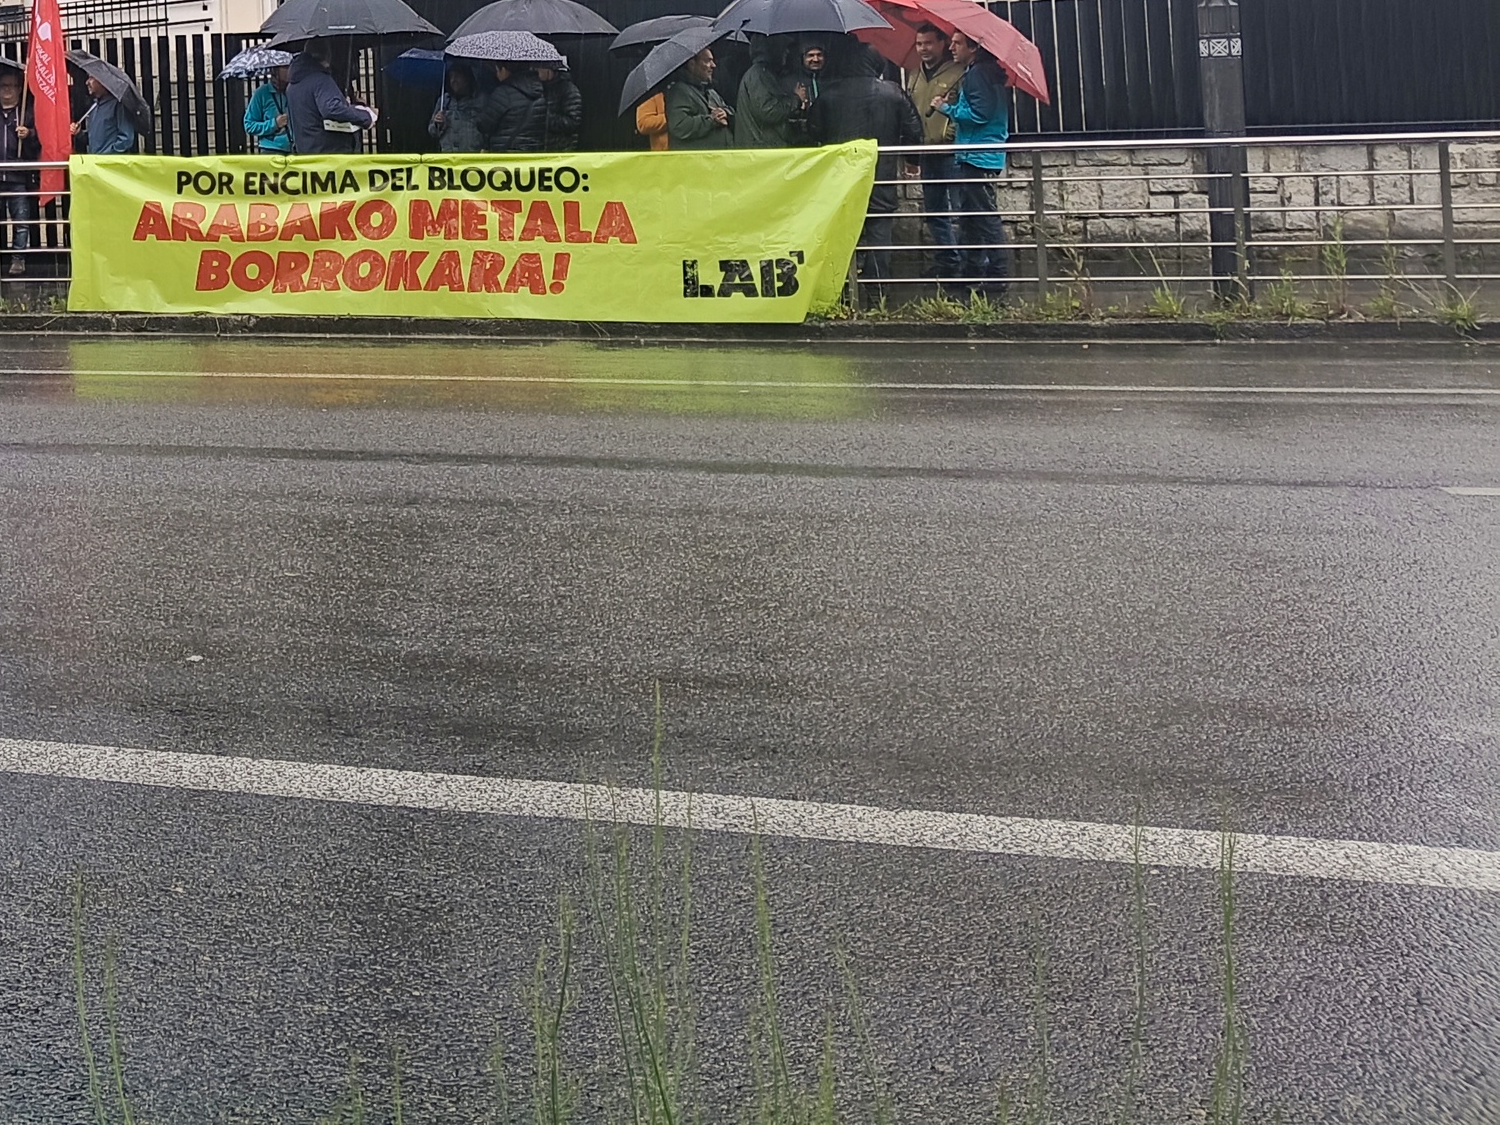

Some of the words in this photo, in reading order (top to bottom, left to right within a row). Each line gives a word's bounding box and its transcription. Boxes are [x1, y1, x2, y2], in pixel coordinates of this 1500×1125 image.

[176, 170, 235, 195] POR
[244, 169, 360, 195] ENCIMA
[369, 167, 419, 192] DEL
[428, 166, 590, 193] BLOQUEO:
[132, 199, 398, 243] ARABAKO
[409, 198, 638, 245] METALA
[195, 249, 571, 295] BORROKARA!
